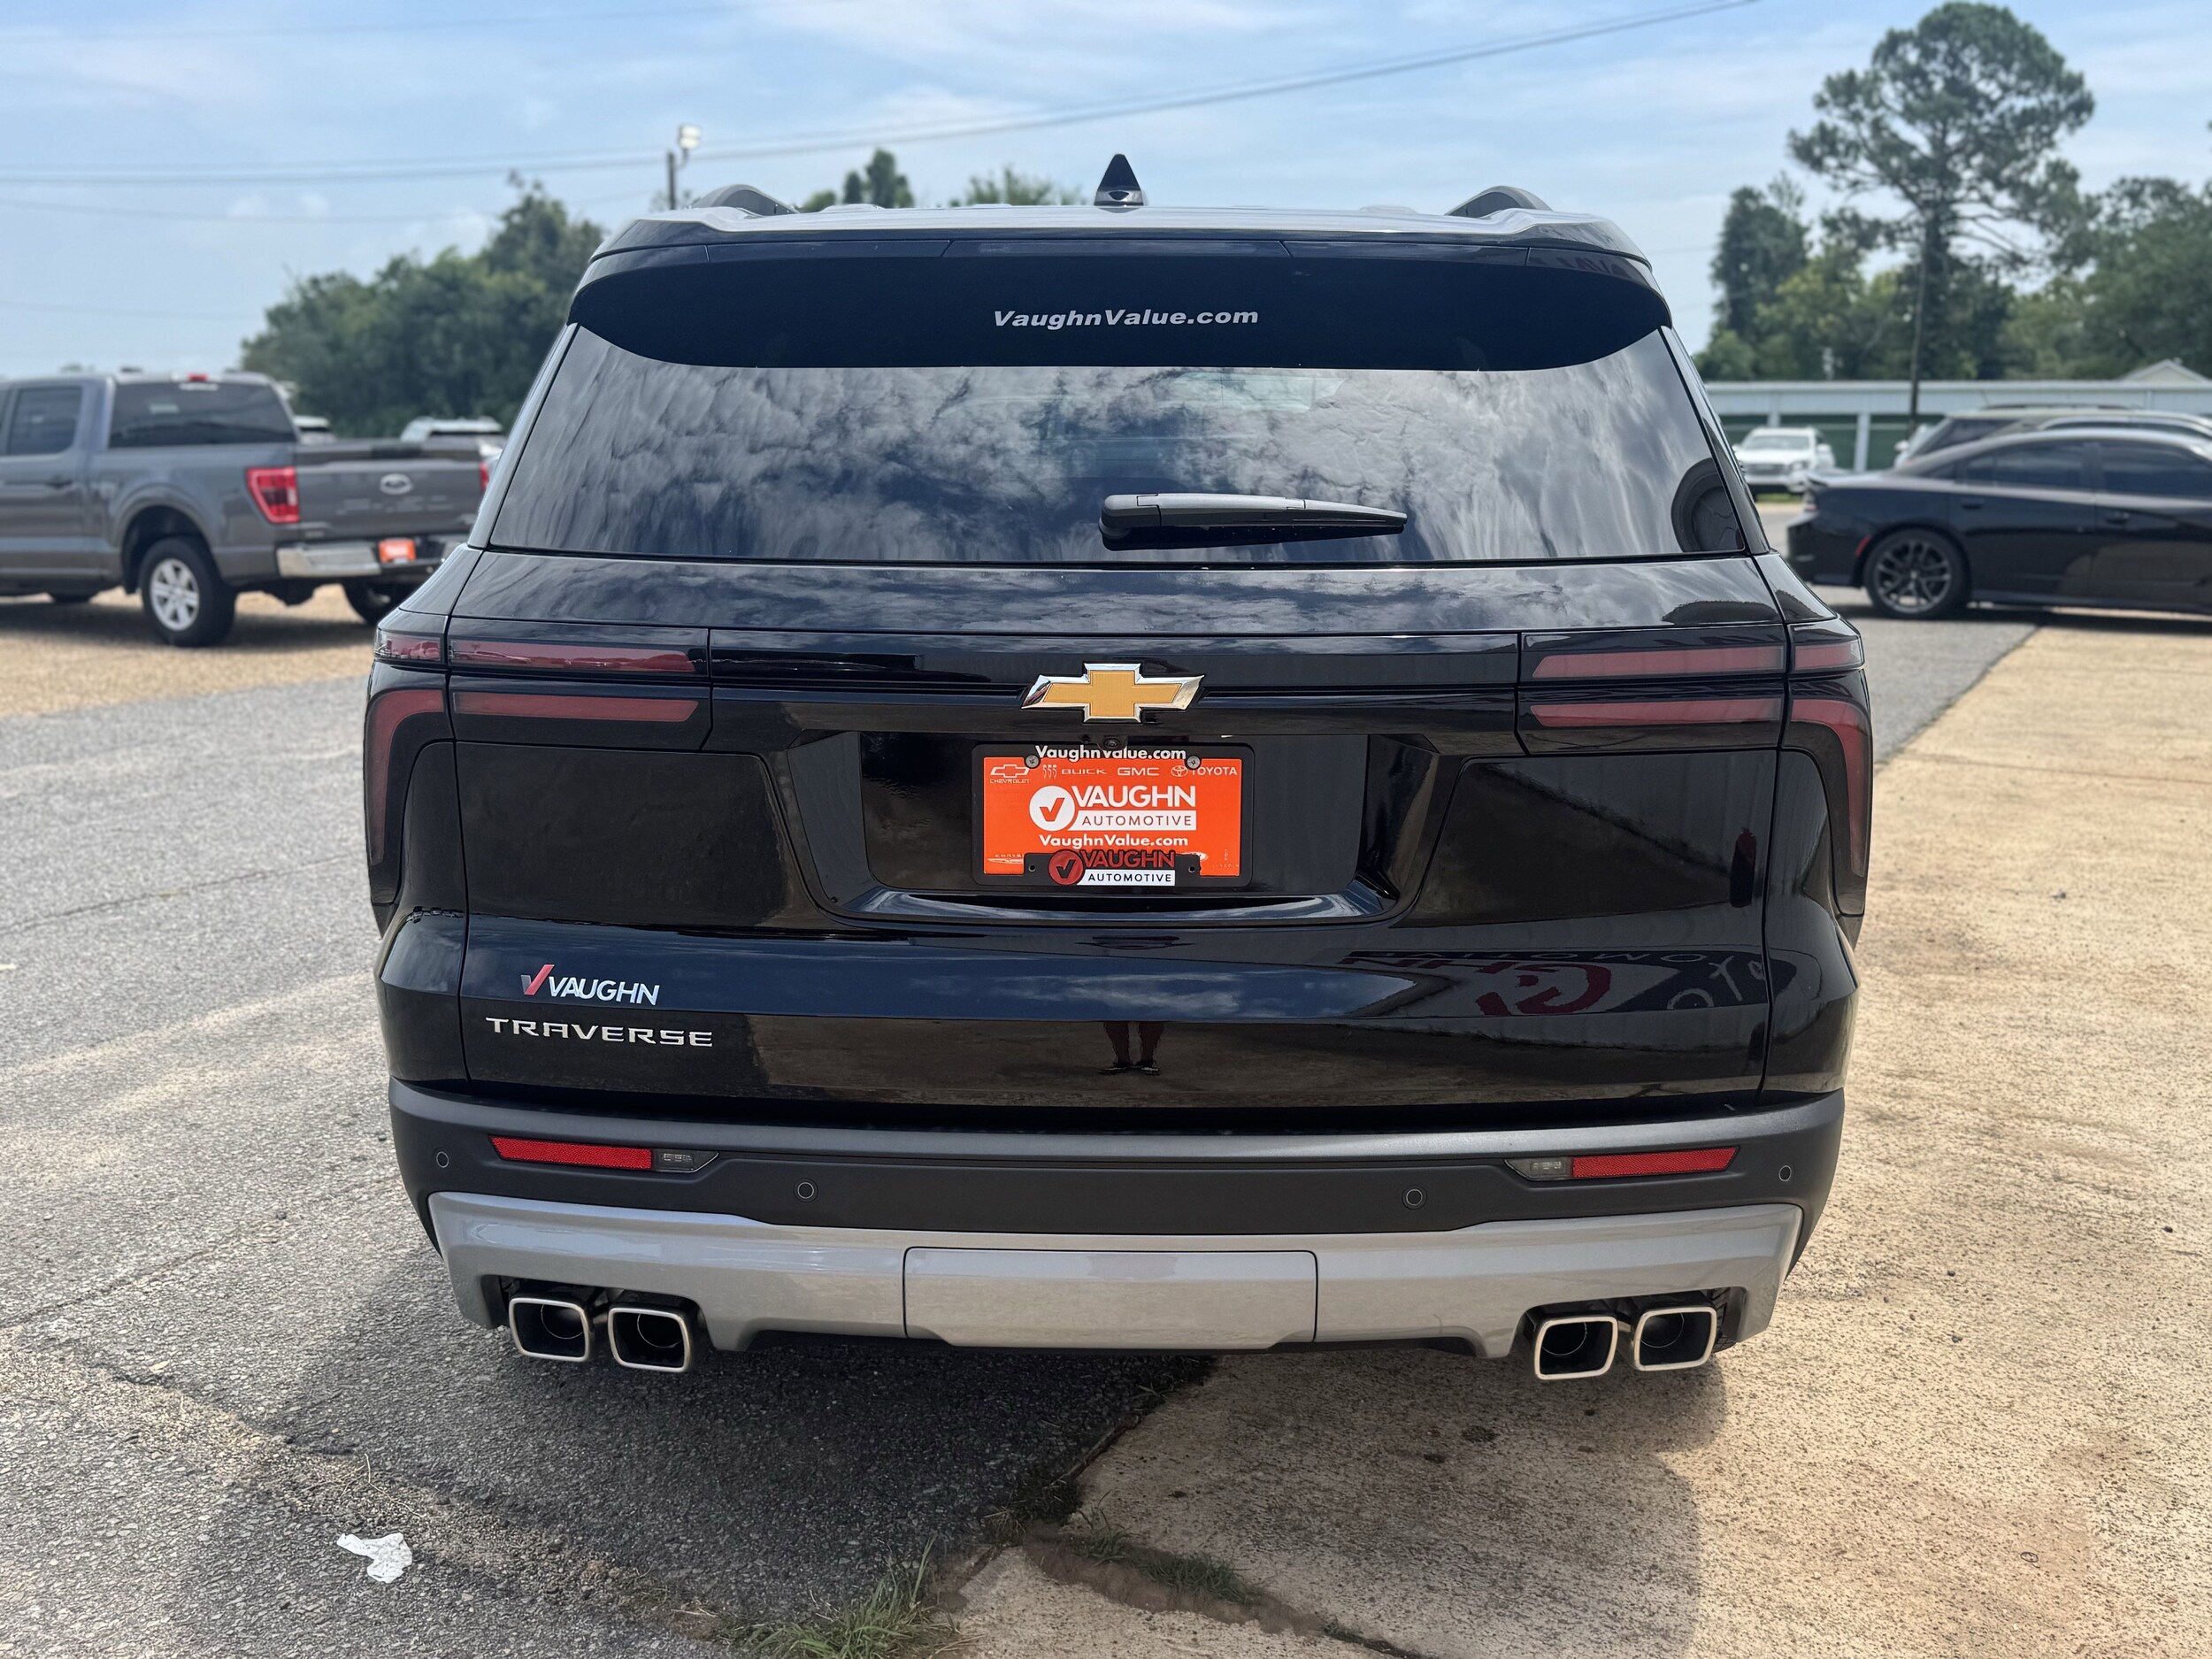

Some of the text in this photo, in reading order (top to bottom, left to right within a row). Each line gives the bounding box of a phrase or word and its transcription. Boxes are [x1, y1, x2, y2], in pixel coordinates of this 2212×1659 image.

[994, 309, 1259, 330] VaughnValue.com
[1035, 744, 1187, 763] VaughnValue.com
[1117, 767, 1160, 776] GMC
[1071, 785, 1196, 808] VAUGHN
[1081, 815, 1192, 826] AUTOMOTIVE
[1039, 833, 1188, 849] VaughnValue.com
[1080, 850, 1175, 868] VAUGHN
[1087, 873, 1171, 882] AUTOMOTIVE
[549, 976, 660, 1006] VAUGHN
[486, 1017, 713, 1048] TRAVERSE
